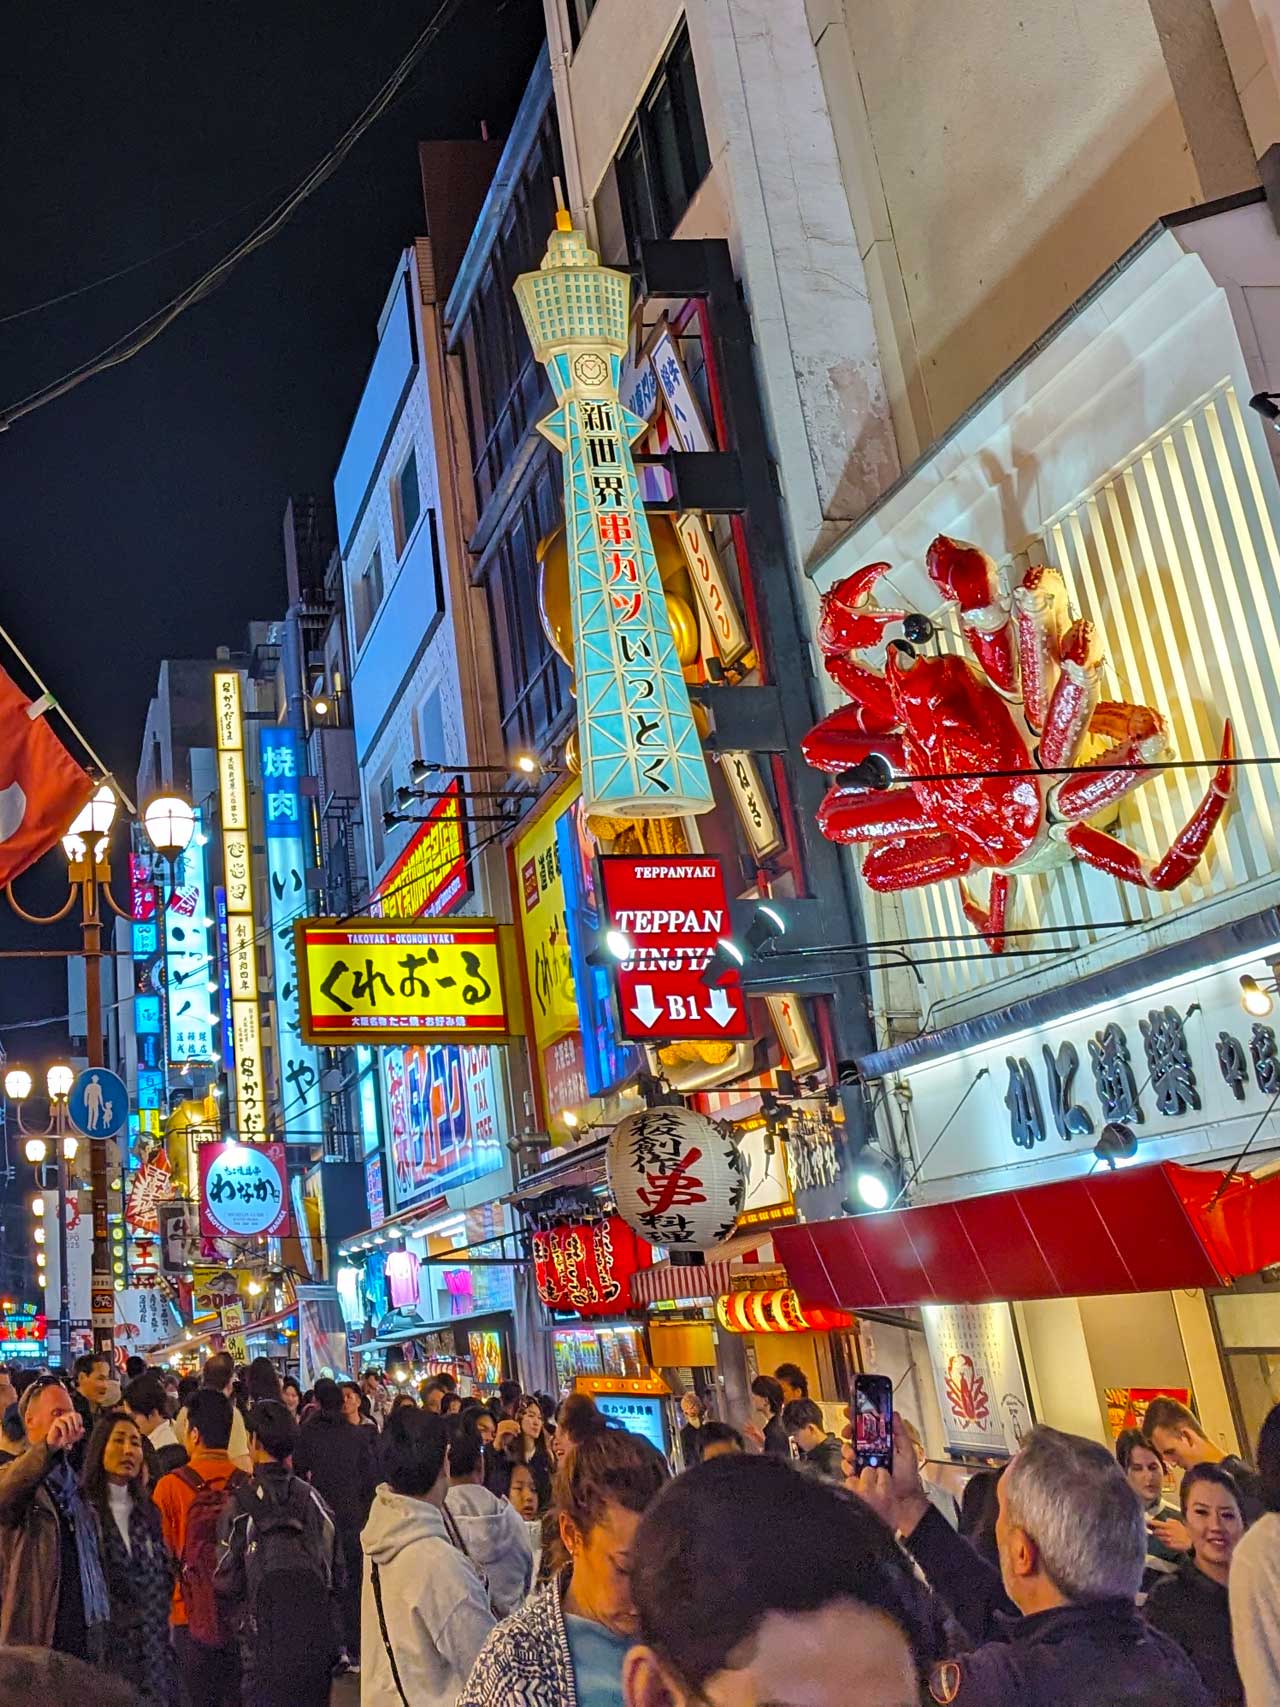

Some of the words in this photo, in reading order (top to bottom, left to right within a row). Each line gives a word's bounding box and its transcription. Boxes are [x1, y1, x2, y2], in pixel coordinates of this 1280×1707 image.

[580, 402, 670, 793] 新世界串カツいっとく
[263, 746, 297, 821] 焼肉
[634, 866, 716, 879] TEPPANYAKI
[615, 910, 723, 933] TEPPAN
[320, 947, 491, 1012] くれおーる
[666, 995, 701, 1020] B1
[209, 1173, 276, 1204] わなか
[204, 1208, 229, 1235] TAKOYAKI
